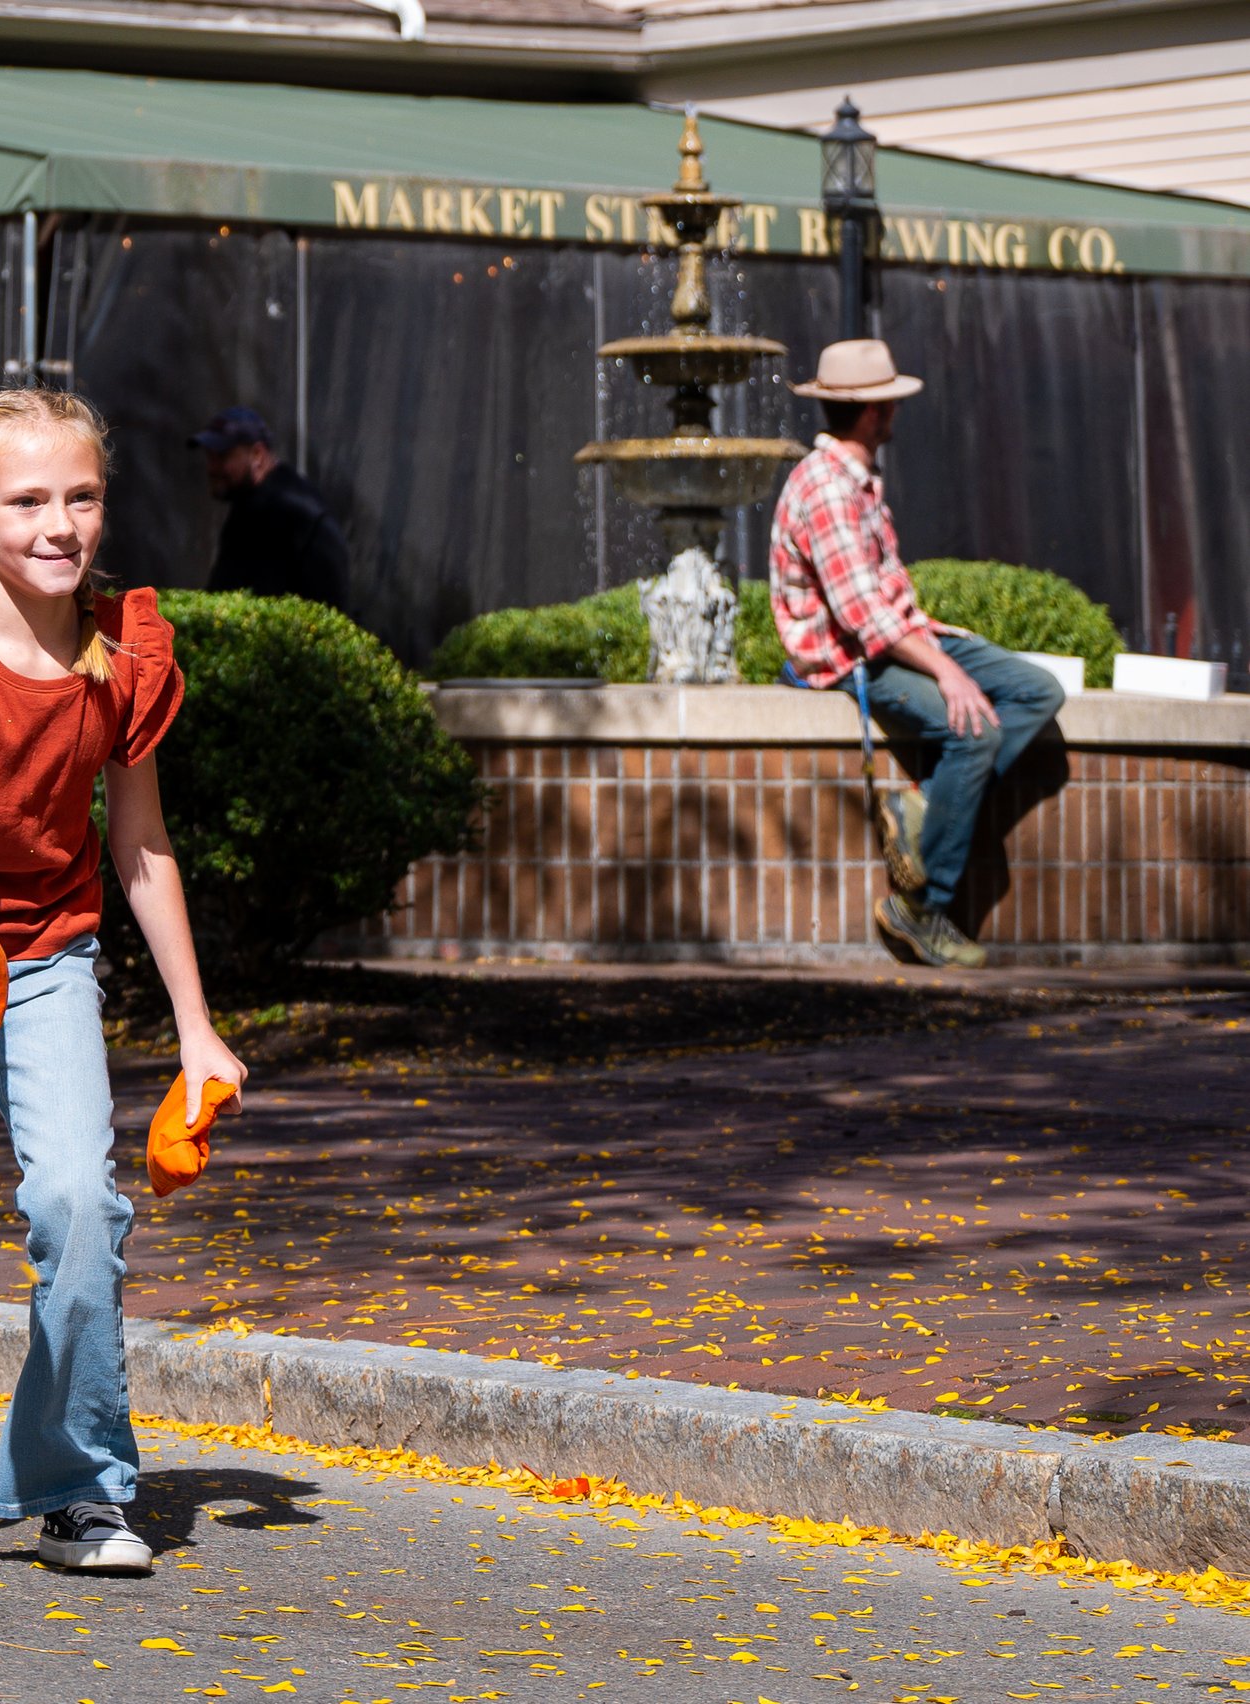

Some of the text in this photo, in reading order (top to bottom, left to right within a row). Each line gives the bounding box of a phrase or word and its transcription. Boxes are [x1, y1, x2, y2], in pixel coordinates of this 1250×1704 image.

[333, 180, 565, 240] MARKET
[585, 193, 778, 255] STRET
[1048, 225, 1125, 274] CO.
